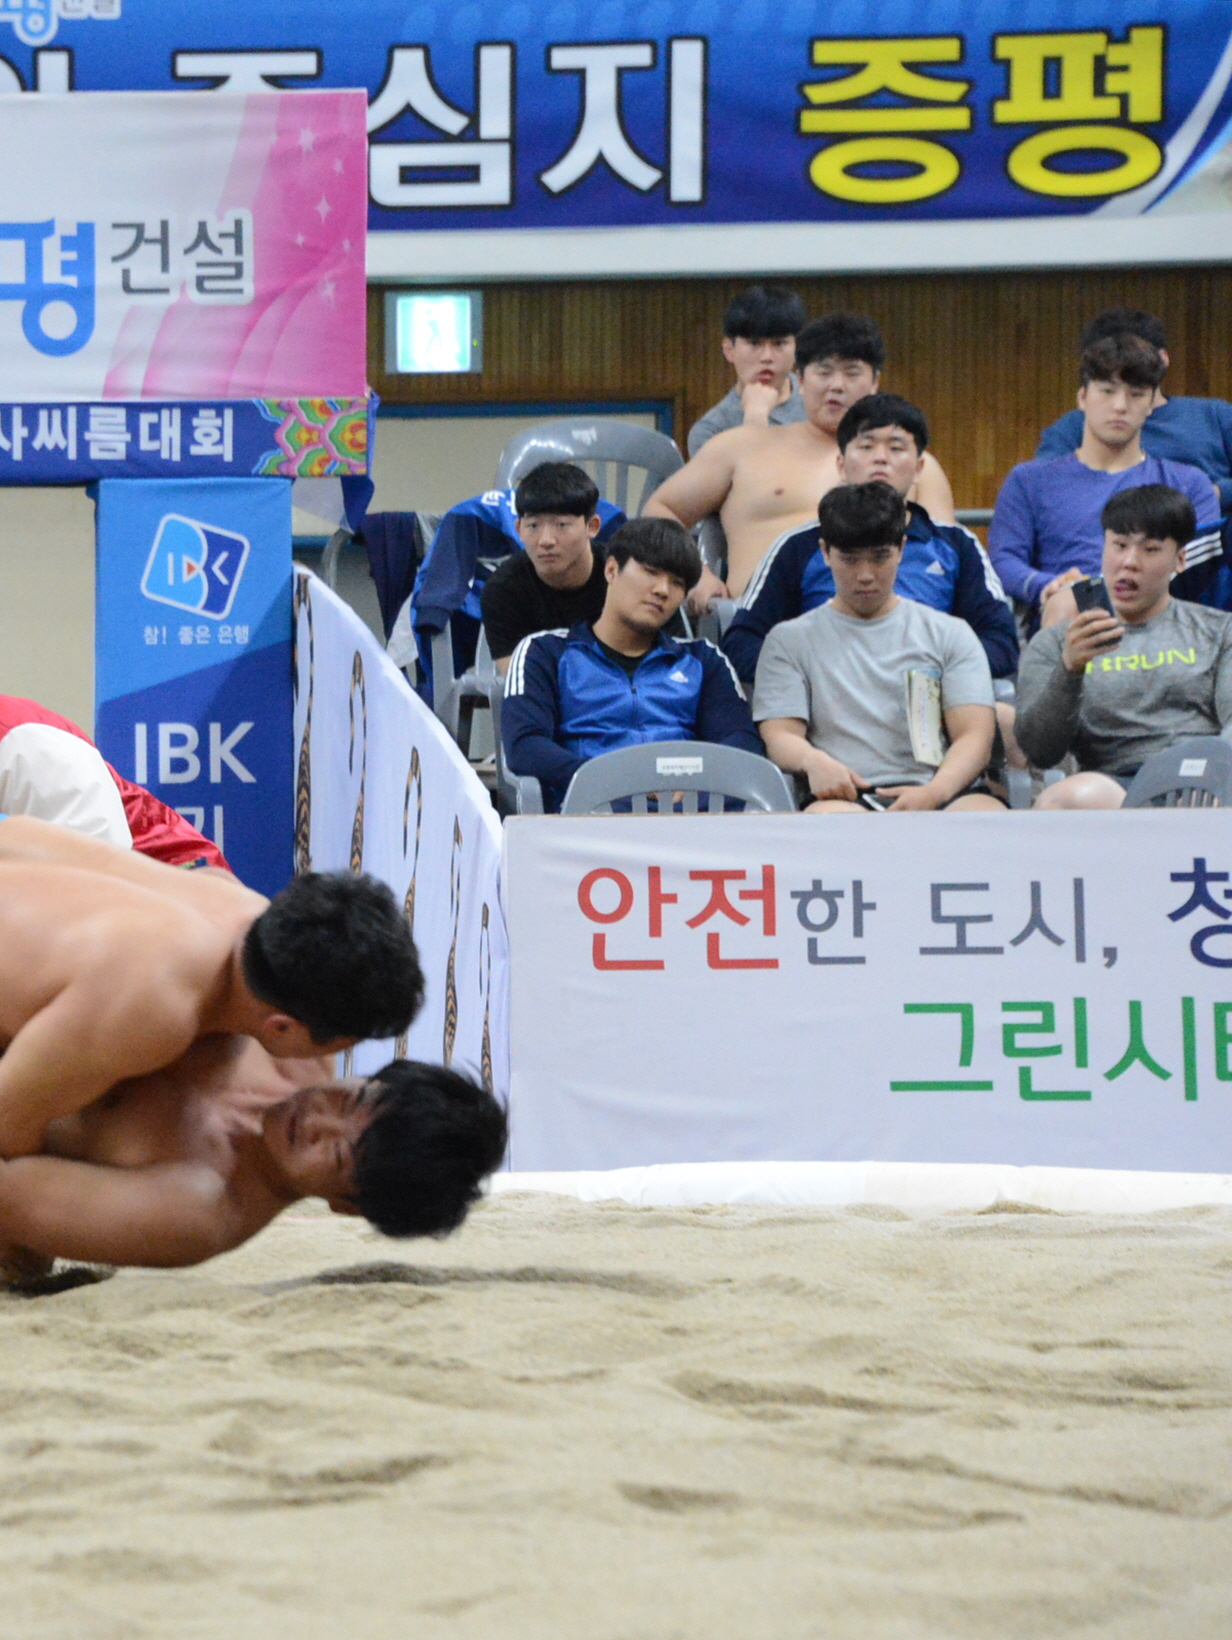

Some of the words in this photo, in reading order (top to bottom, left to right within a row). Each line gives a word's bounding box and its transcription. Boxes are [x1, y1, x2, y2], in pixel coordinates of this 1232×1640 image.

[798, 25, 1166, 204] 증평
[110, 218, 245, 295] 건설
[178, 625, 212, 646] 좋은
[217, 624, 250, 646] 은행
[135, 722, 257, 785] IBK
[576, 863, 877, 972] 안전한
[918, 876, 1119, 970] 도시,
